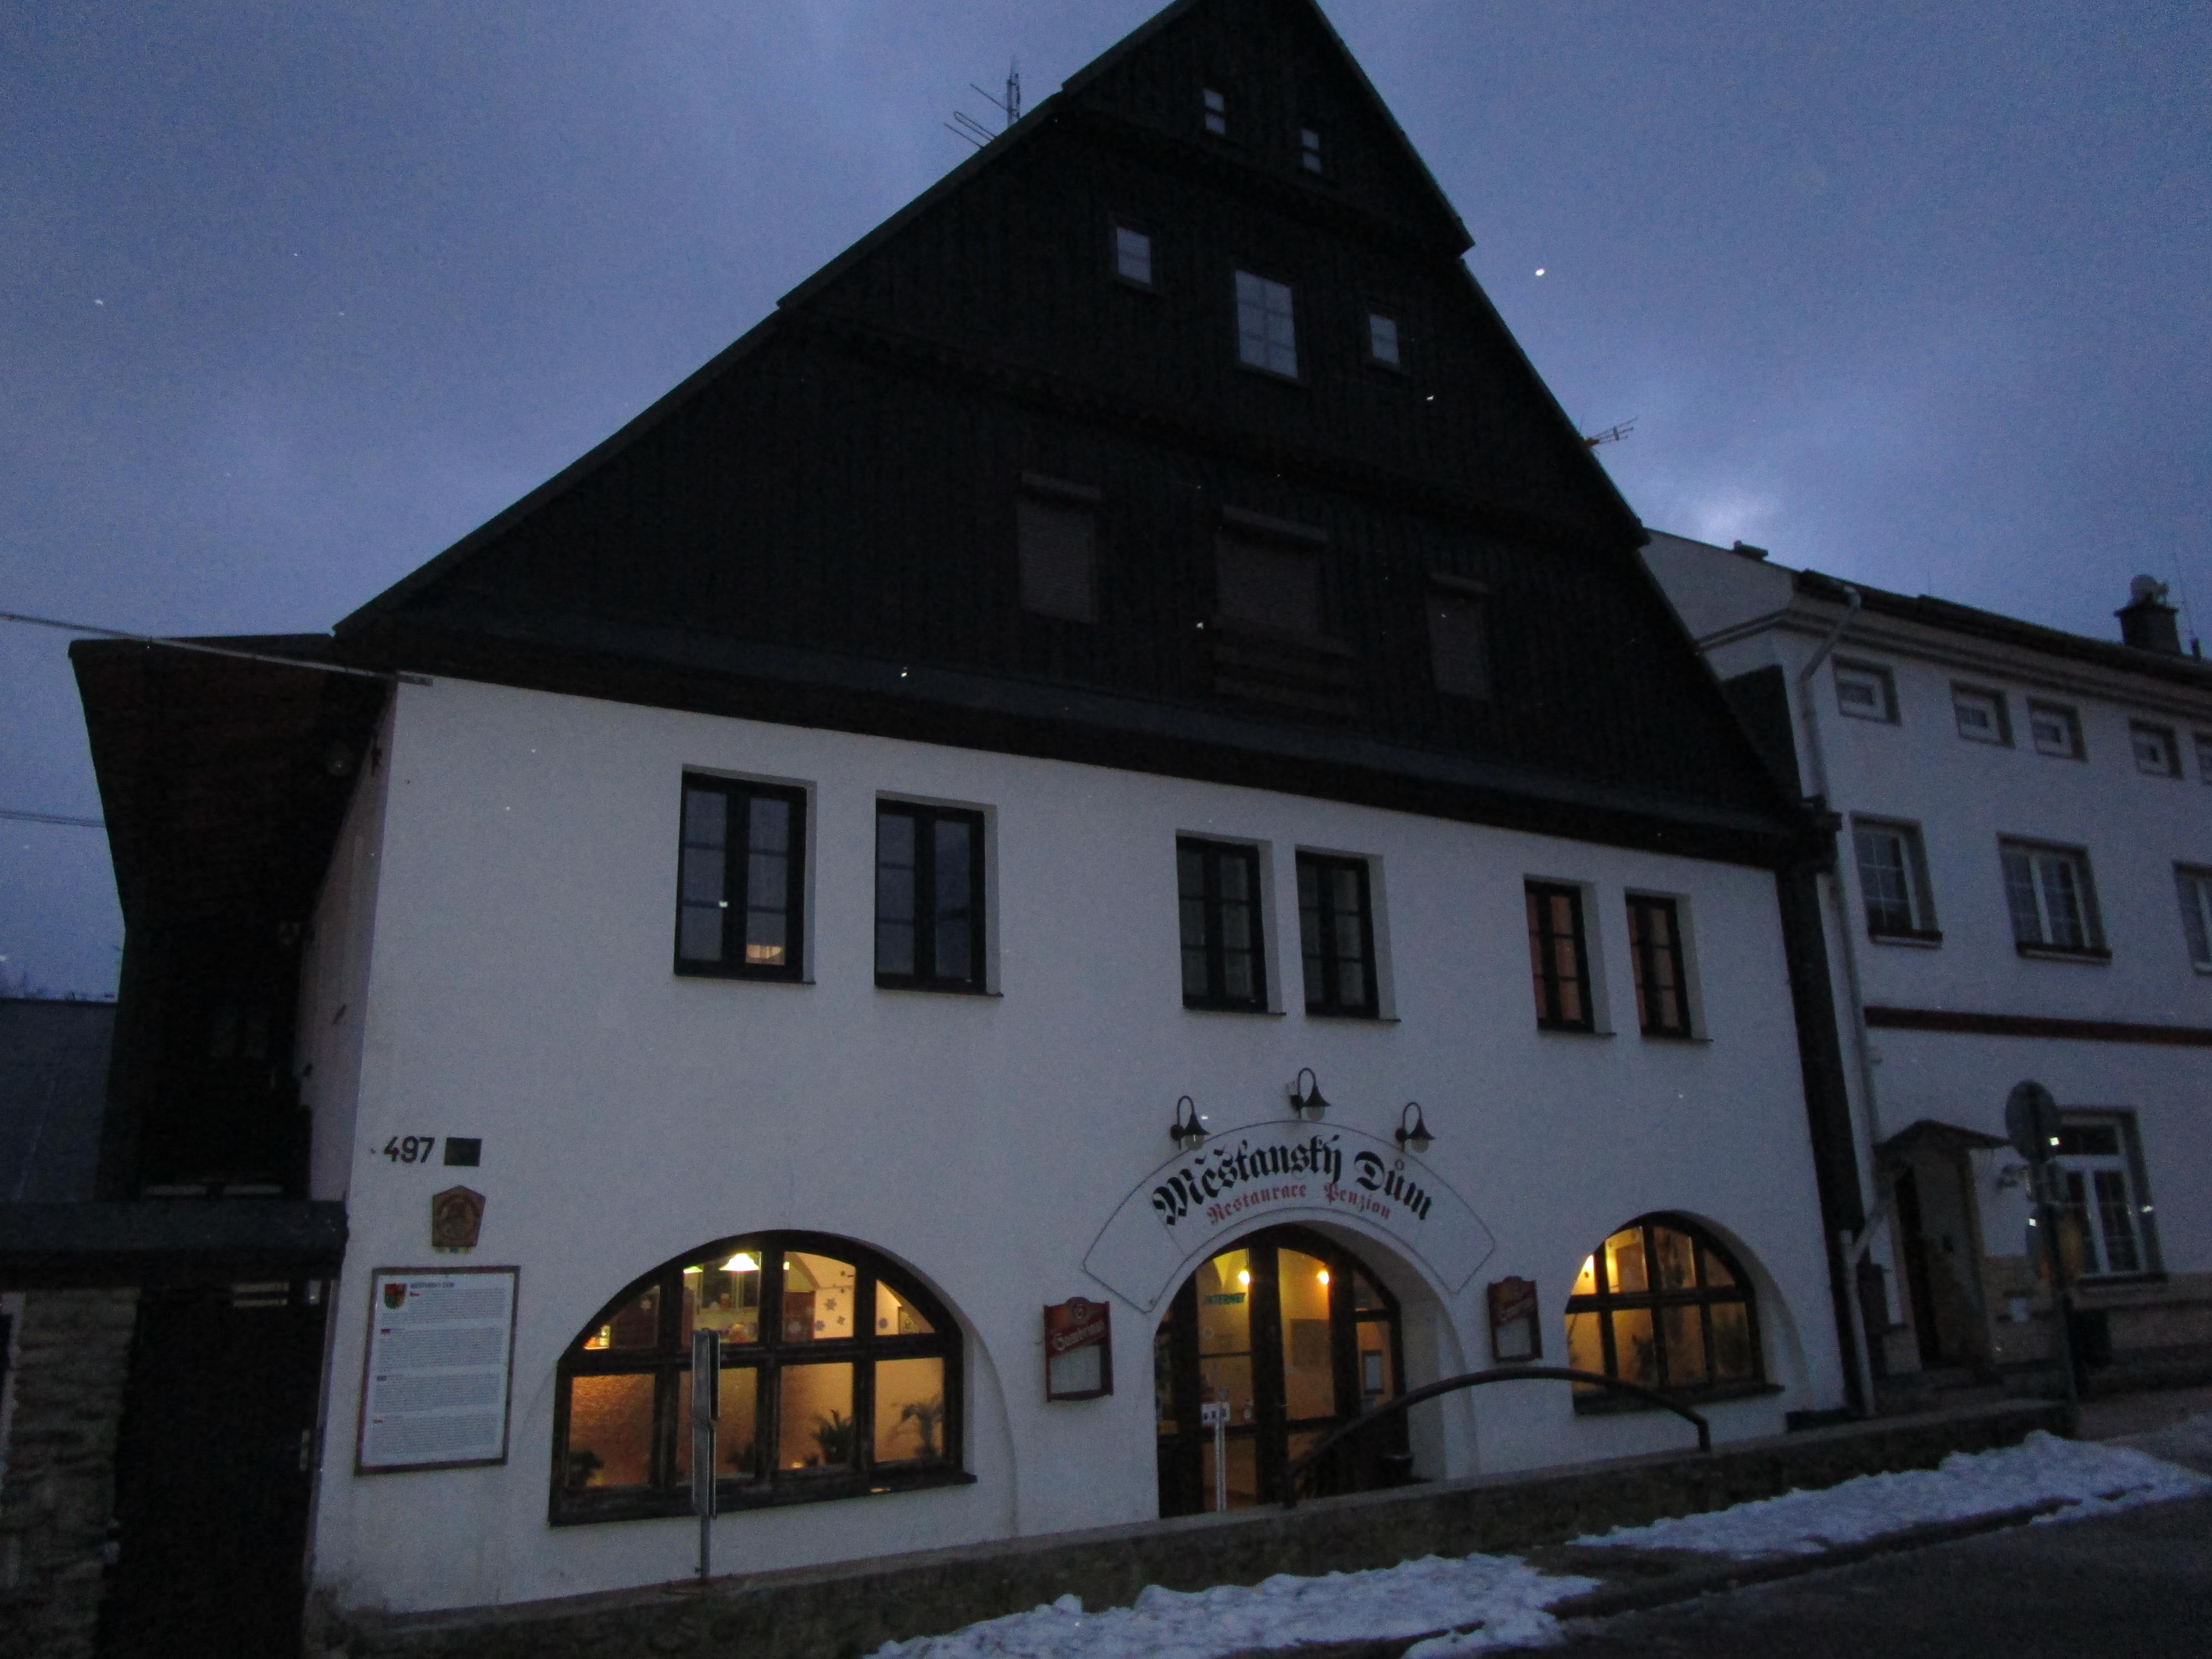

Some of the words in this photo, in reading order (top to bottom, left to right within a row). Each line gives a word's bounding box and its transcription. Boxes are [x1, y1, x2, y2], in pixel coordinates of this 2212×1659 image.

[384, 1136, 435, 1164] 497
[1152, 1135, 1342, 1226] Měšťanský
[1354, 1151, 1432, 1220] Dům
[1207, 1184, 1307, 1225] Restaurace
[1324, 1181, 1391, 1220] Penzion
